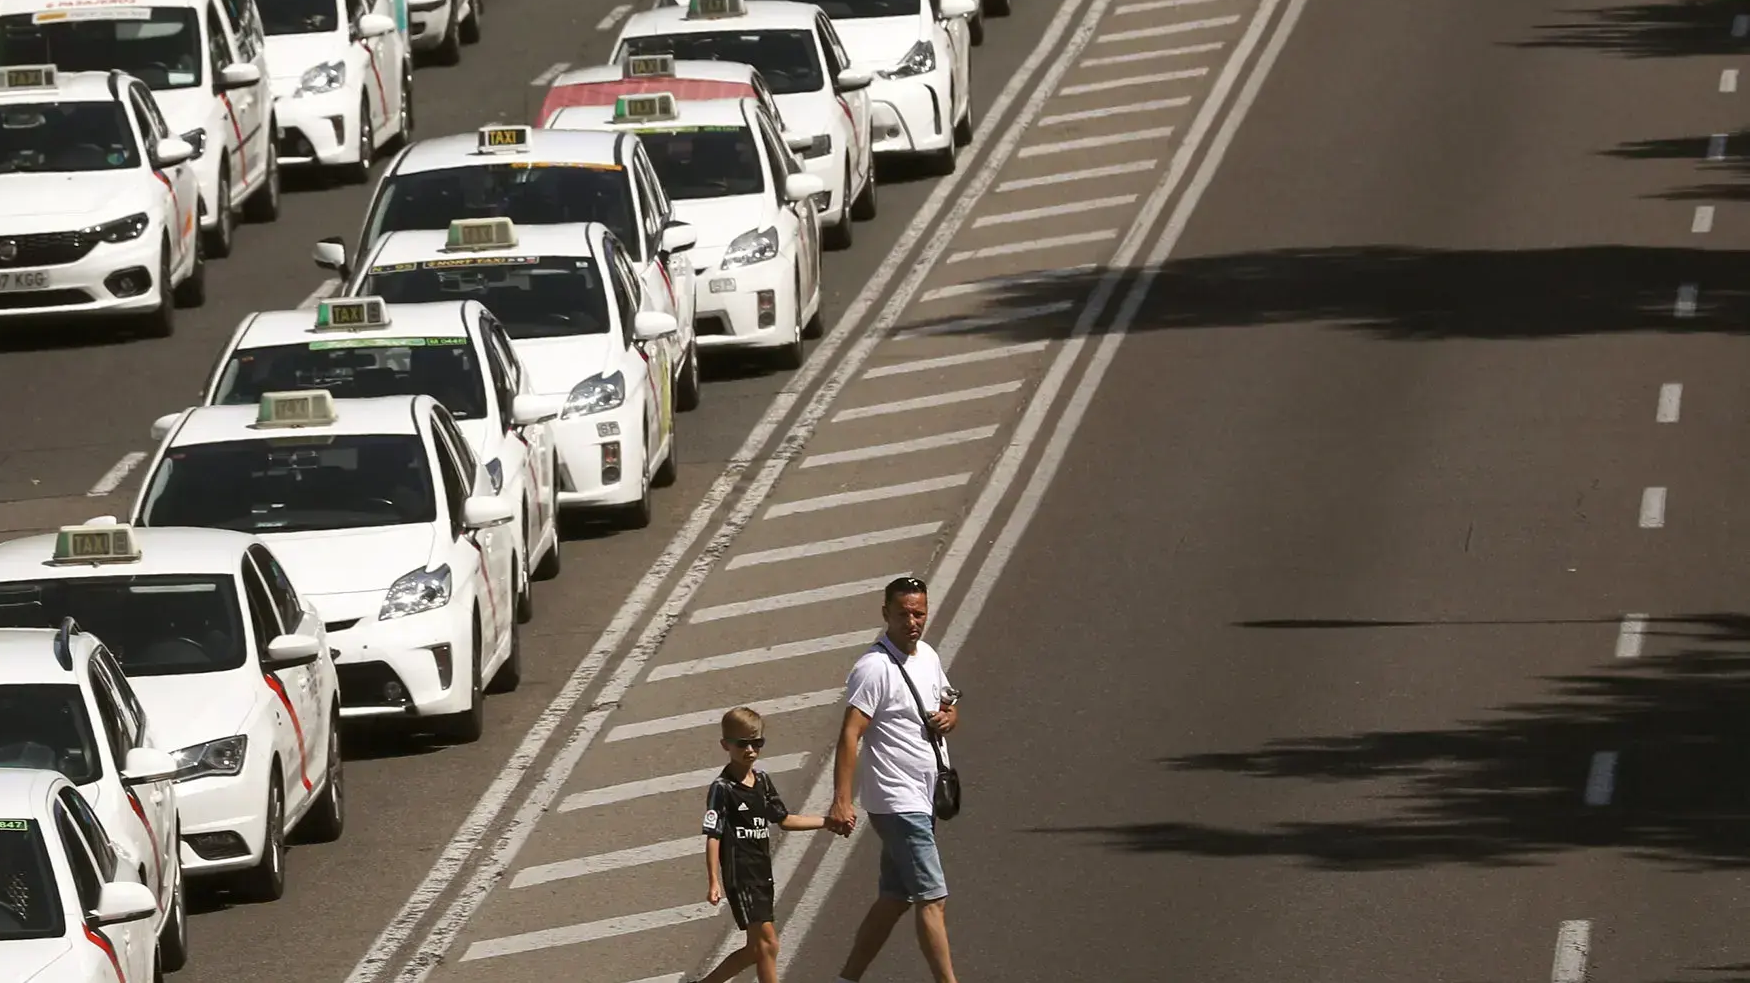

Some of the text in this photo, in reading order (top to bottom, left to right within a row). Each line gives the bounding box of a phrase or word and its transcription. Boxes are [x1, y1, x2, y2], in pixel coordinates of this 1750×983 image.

[633, 61, 656, 73] TAXI
[490, 130, 516, 145] TAXI
[14, 272, 44, 287] KGG
[333, 306, 363, 322] TAXI
[278, 400, 308, 415] TAXI
[75, 536, 109, 553] TAXI
[736, 826, 770, 839] Emirat
